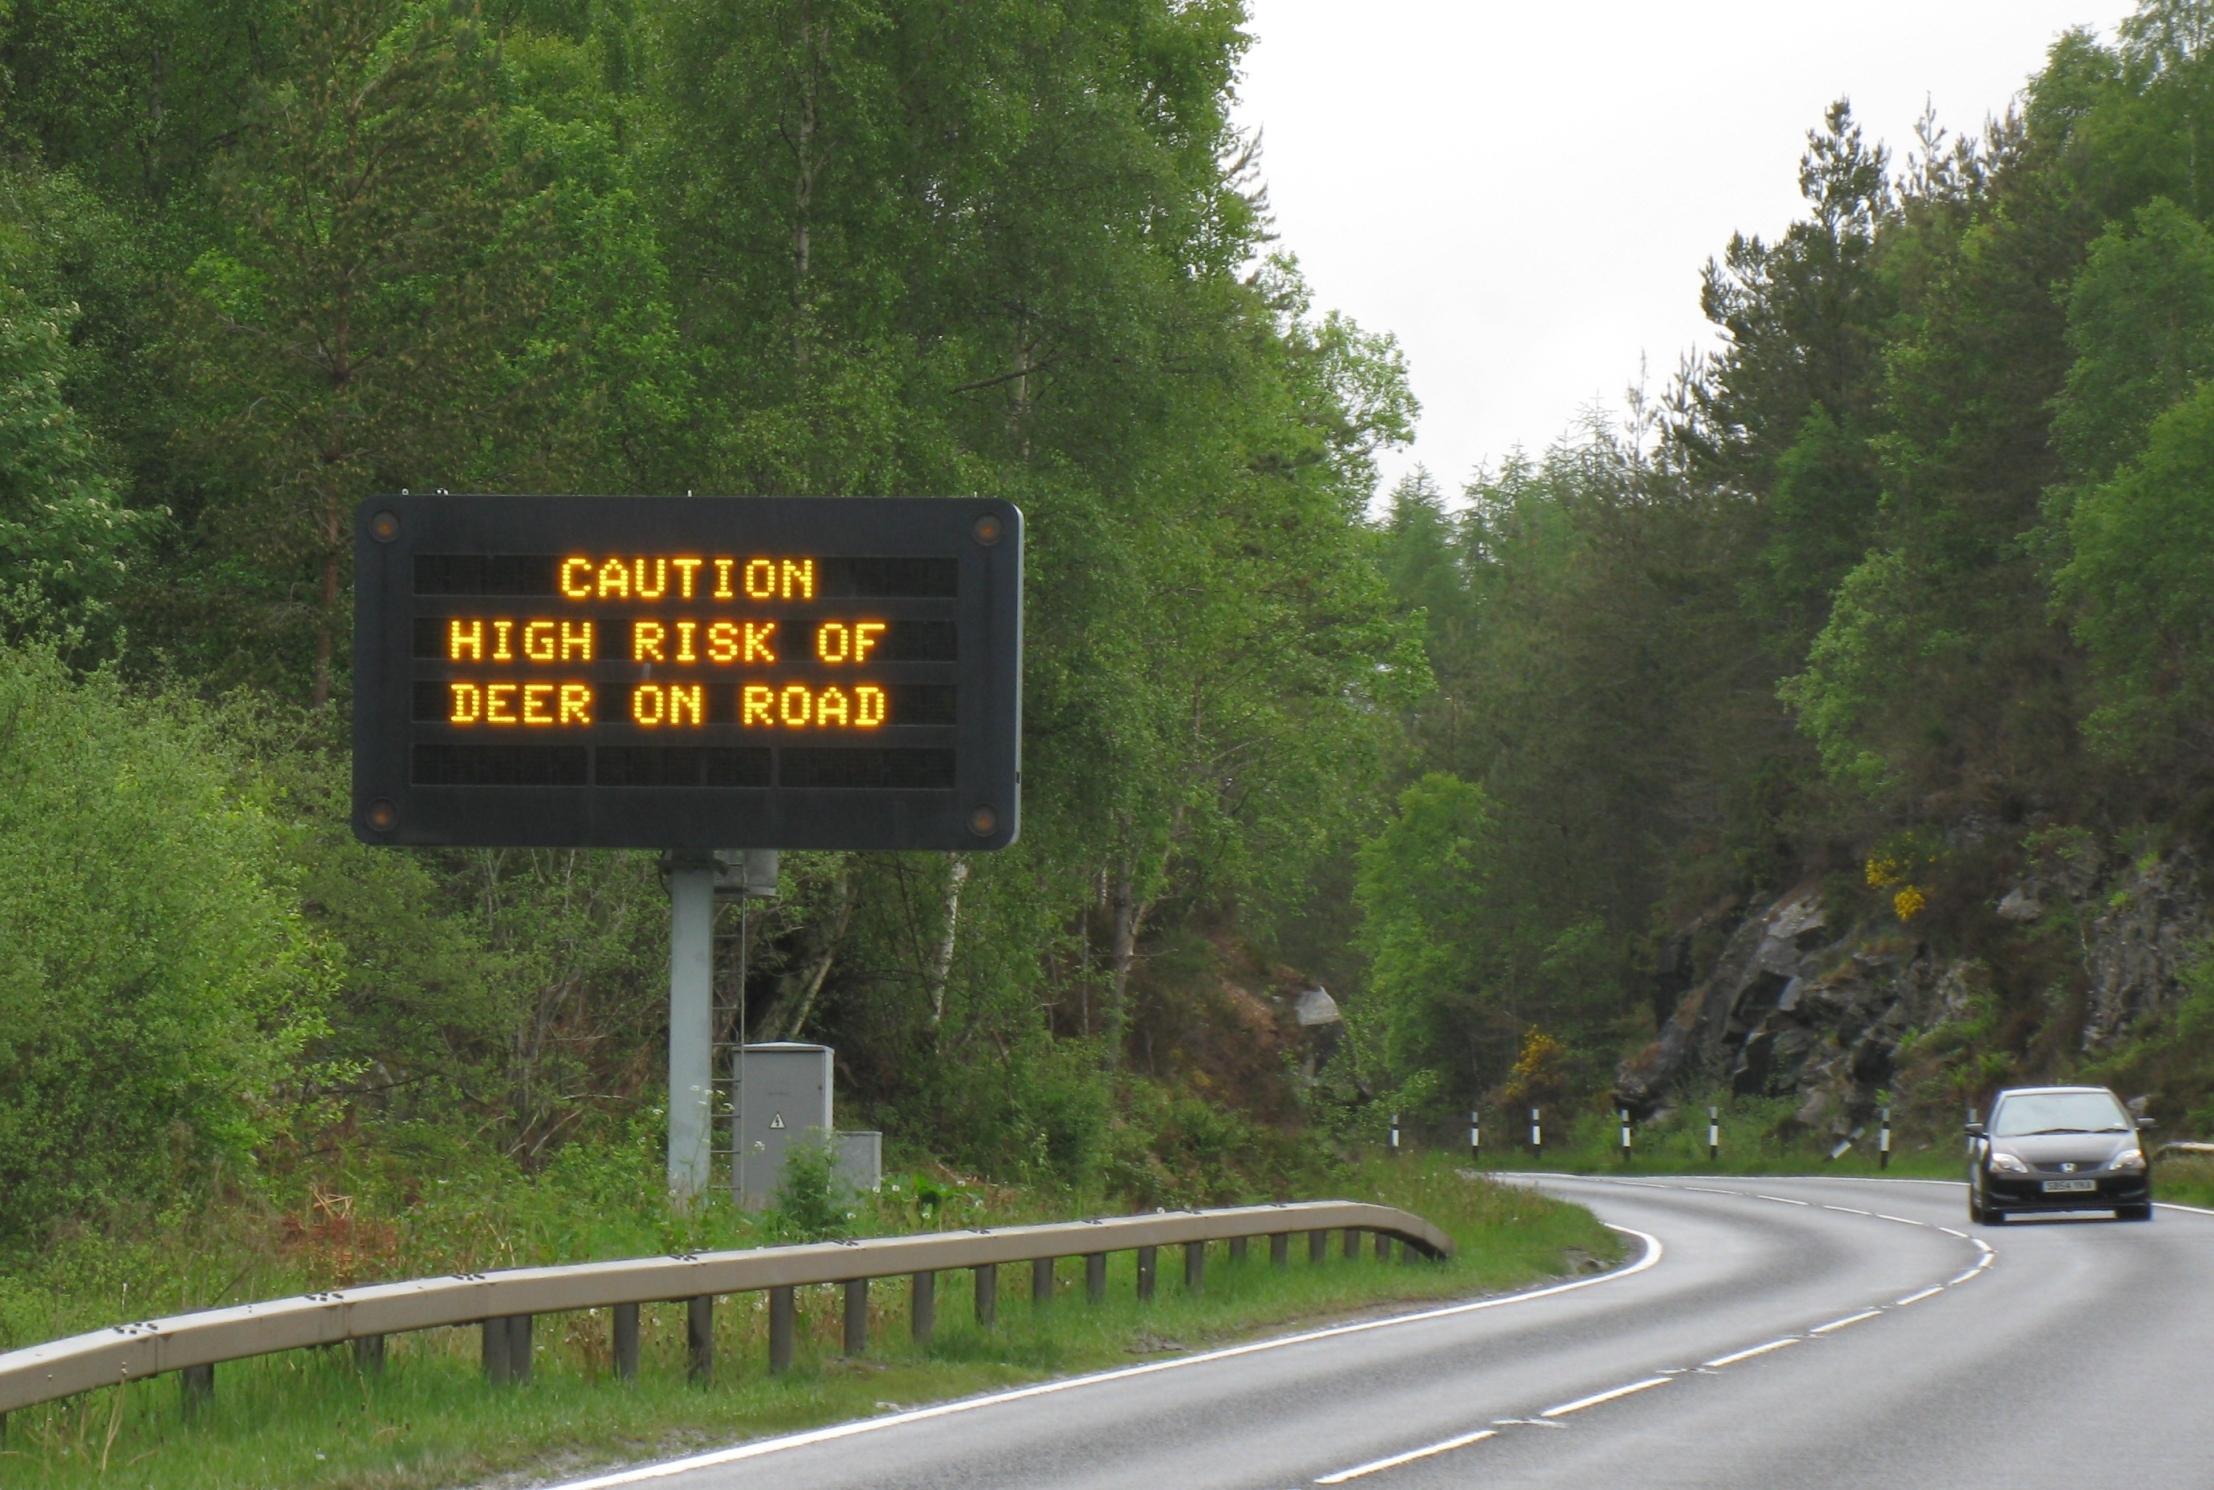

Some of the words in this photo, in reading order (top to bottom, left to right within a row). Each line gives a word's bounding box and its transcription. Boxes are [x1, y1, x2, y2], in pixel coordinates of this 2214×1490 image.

[560, 556, 813, 600] CAUTION
[449, 620, 593, 662] HIGH
[633, 621, 776, 664] RISK
[817, 622, 885, 664] OF
[450, 682, 592, 725] DEER
[633, 684, 703, 726] ON
[743, 684, 885, 728] ROAD
